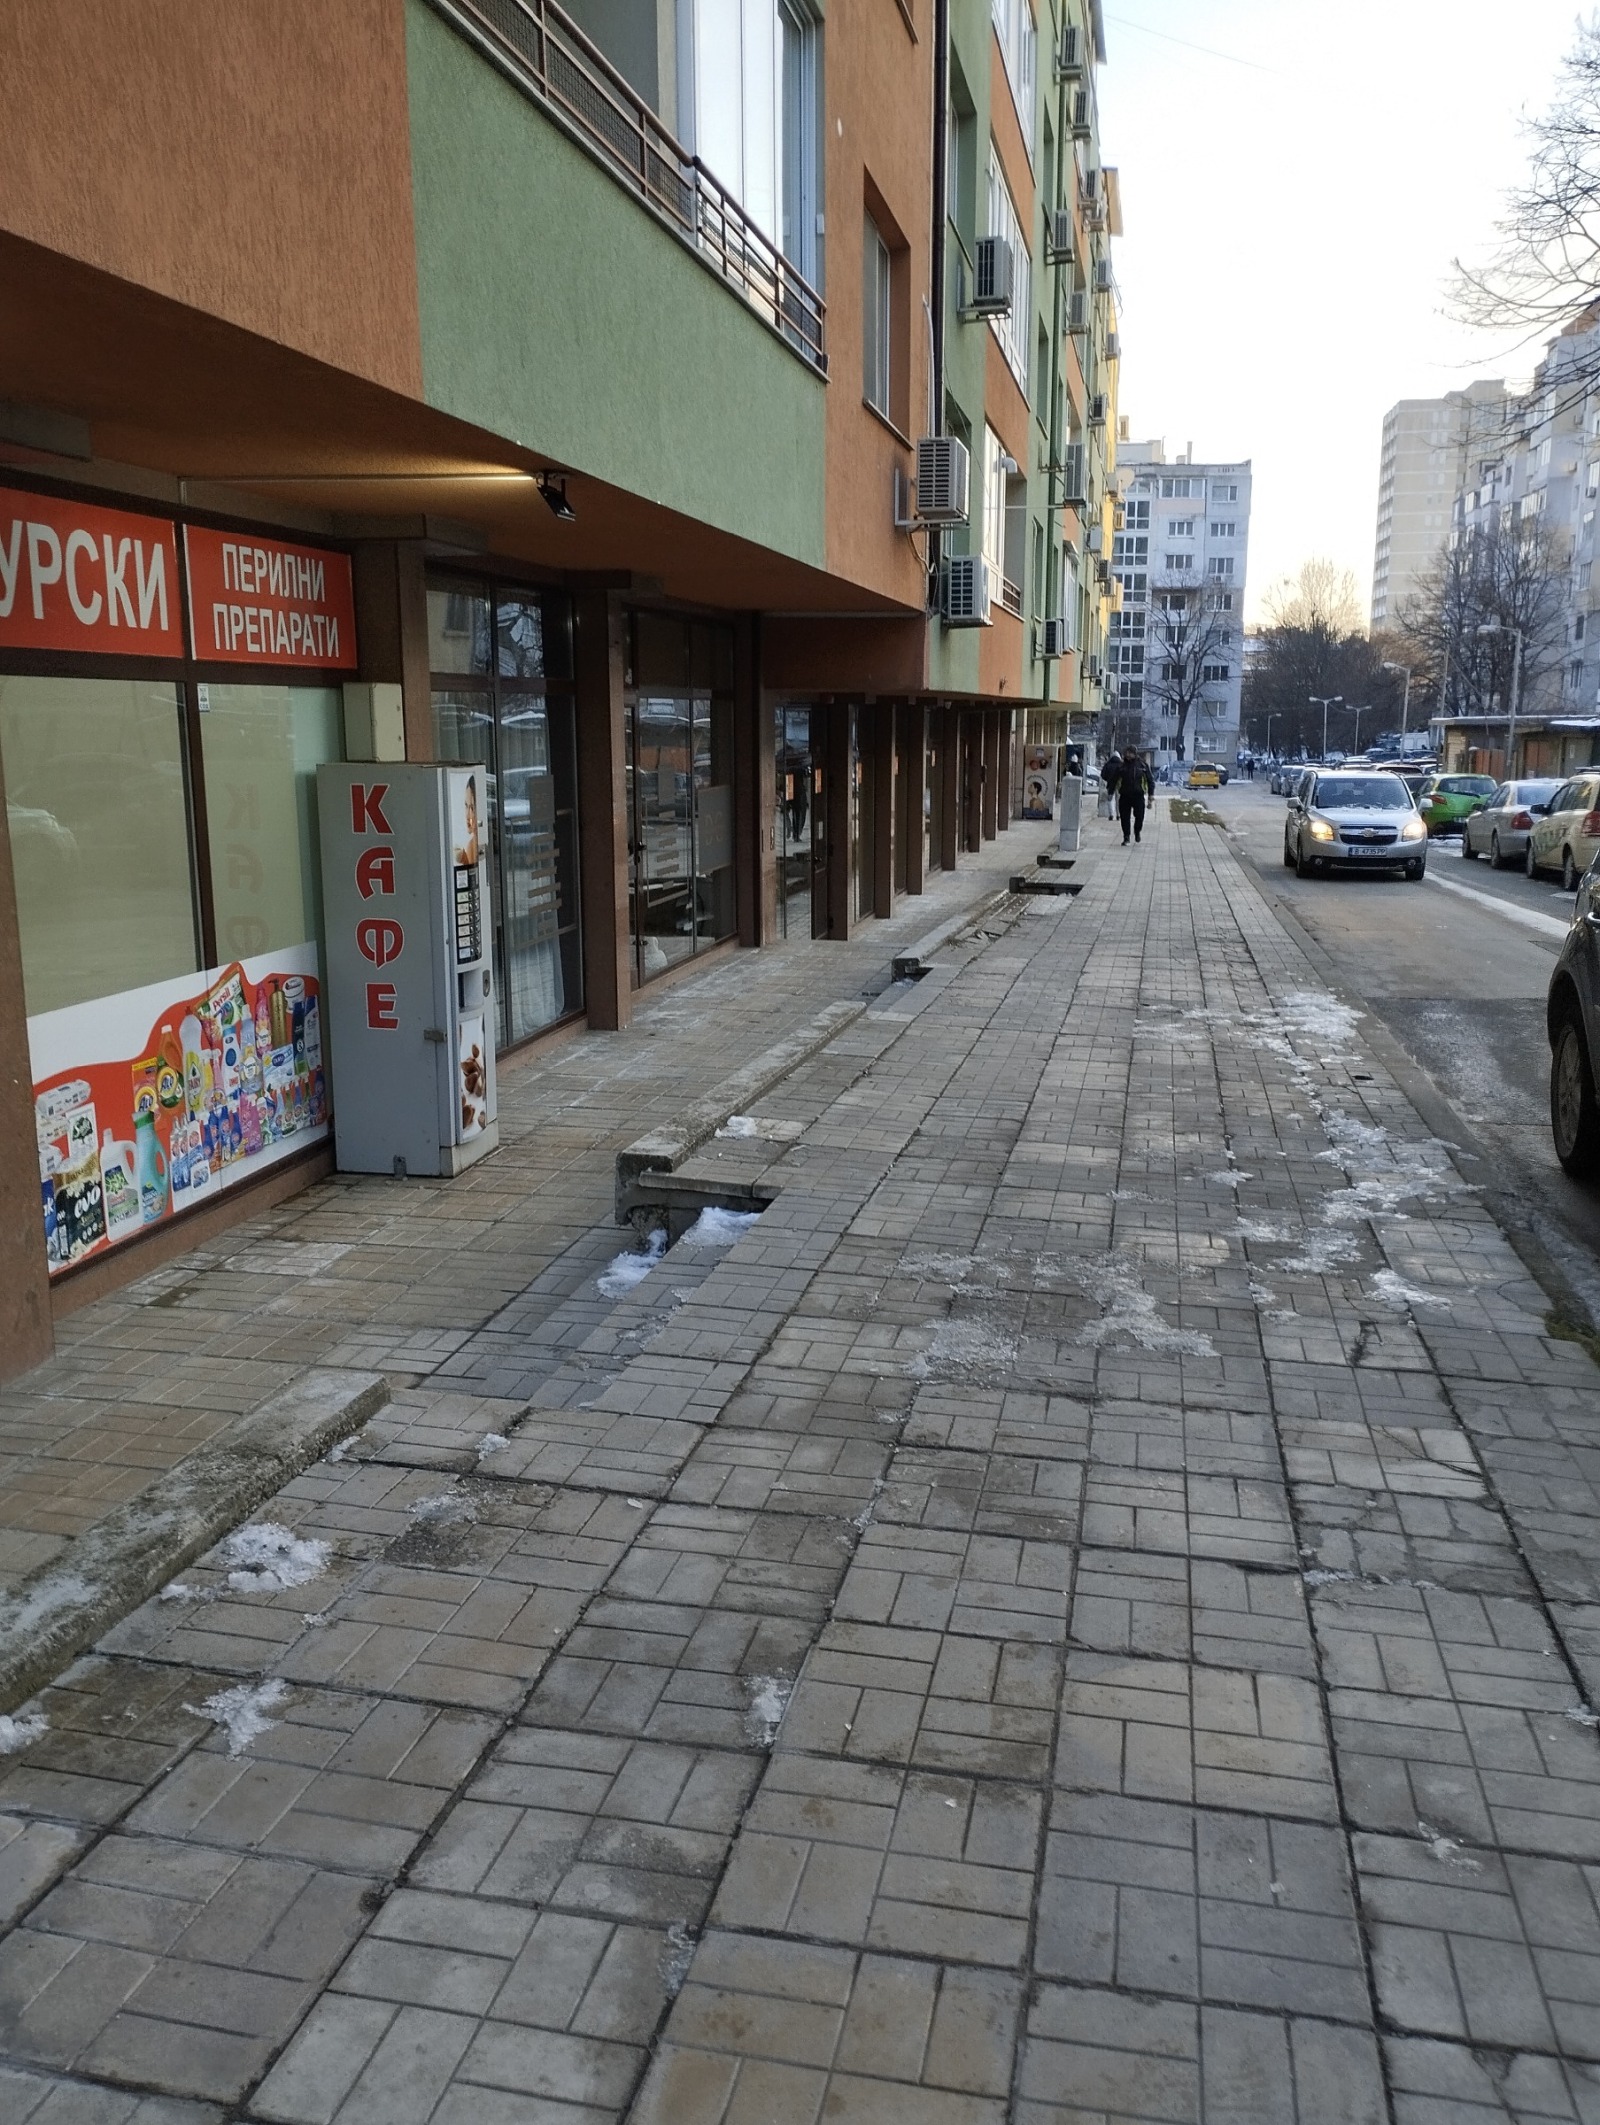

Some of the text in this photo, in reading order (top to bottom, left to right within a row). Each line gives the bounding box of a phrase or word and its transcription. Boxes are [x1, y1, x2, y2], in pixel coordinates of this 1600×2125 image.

[222, 542, 326, 602] ПЕРИЛНИ
[212, 602, 340, 658] ПРЕПАРАТИ
[350, 783, 405, 1031] КАФЕ
[212, 986, 231, 1011] Persil
[74, 1185, 101, 1219] evo
